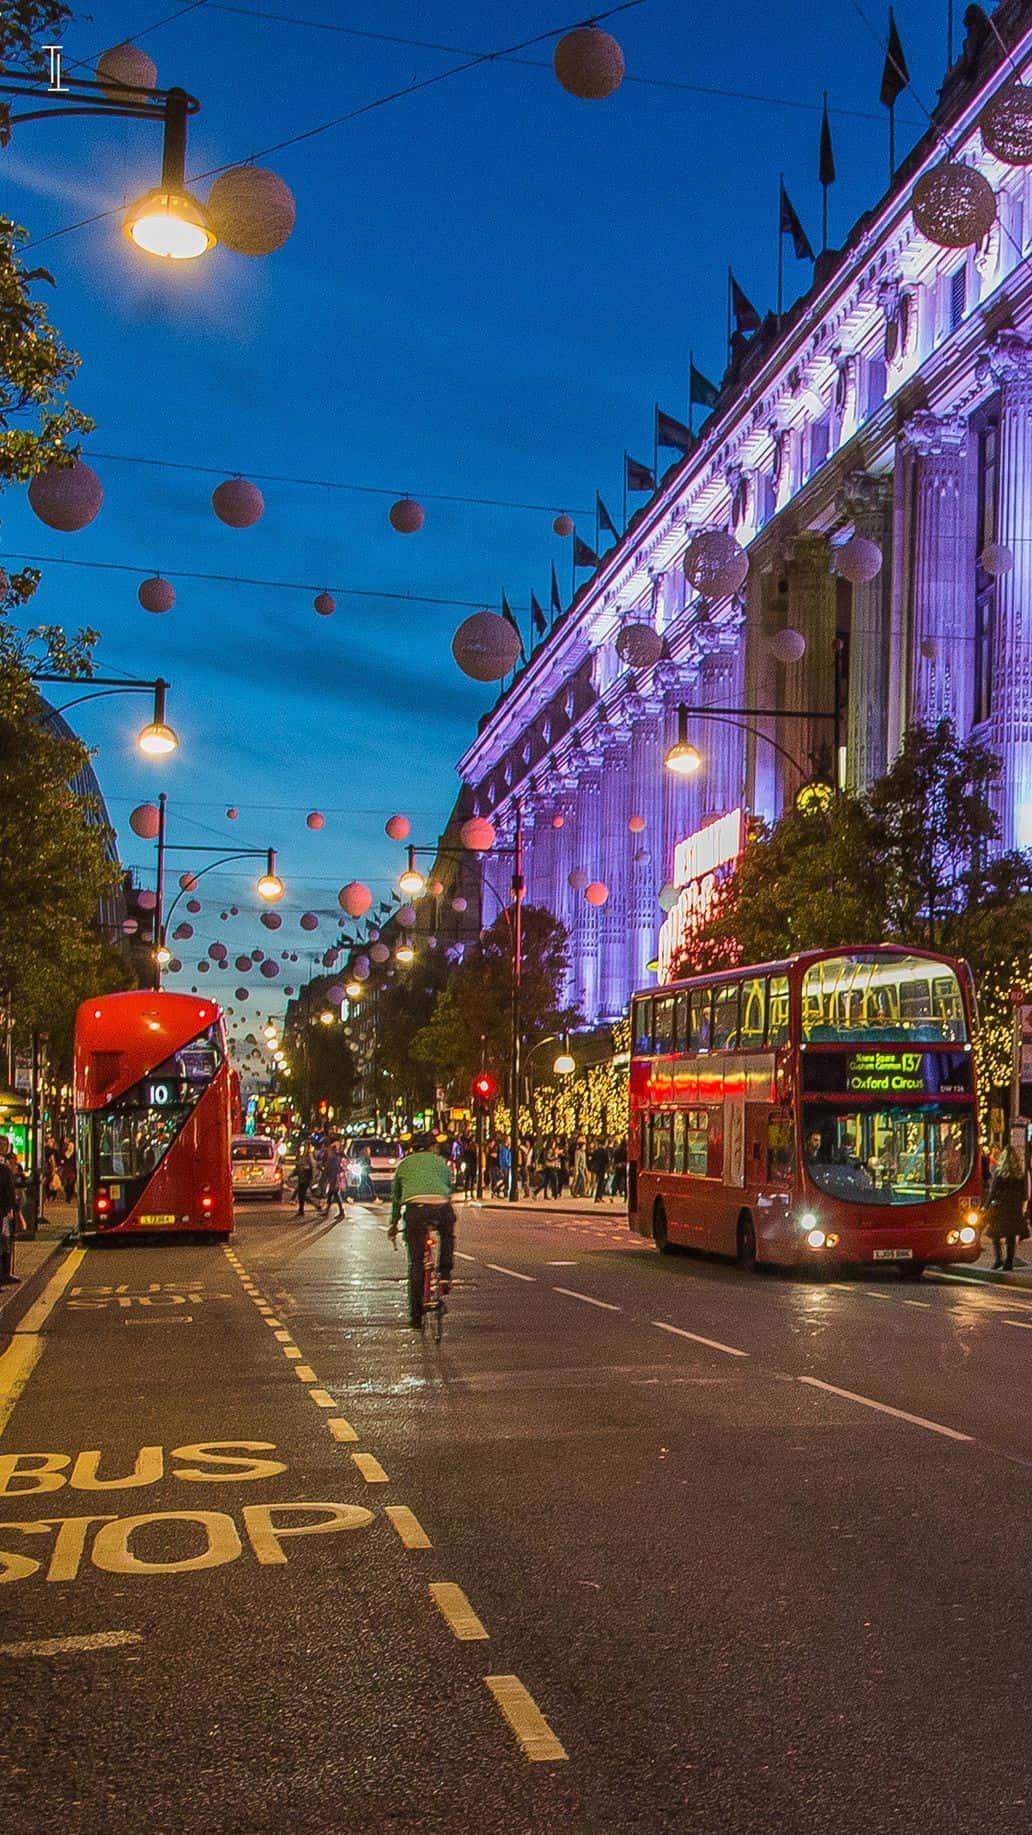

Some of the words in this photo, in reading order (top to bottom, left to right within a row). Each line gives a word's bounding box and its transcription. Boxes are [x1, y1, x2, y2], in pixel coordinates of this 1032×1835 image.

[902, 1053, 922, 1072] 137
[851, 1076, 888, 1089] Oxford
[891, 1076, 924, 1089] Circus
[150, 1085, 168, 1104] 10
[70, 1281, 204, 1296] BUS
[66, 1293, 232, 1311] STOP
[0, 1441, 288, 1497] BUS
[0, 1502, 375, 1583] STOP
